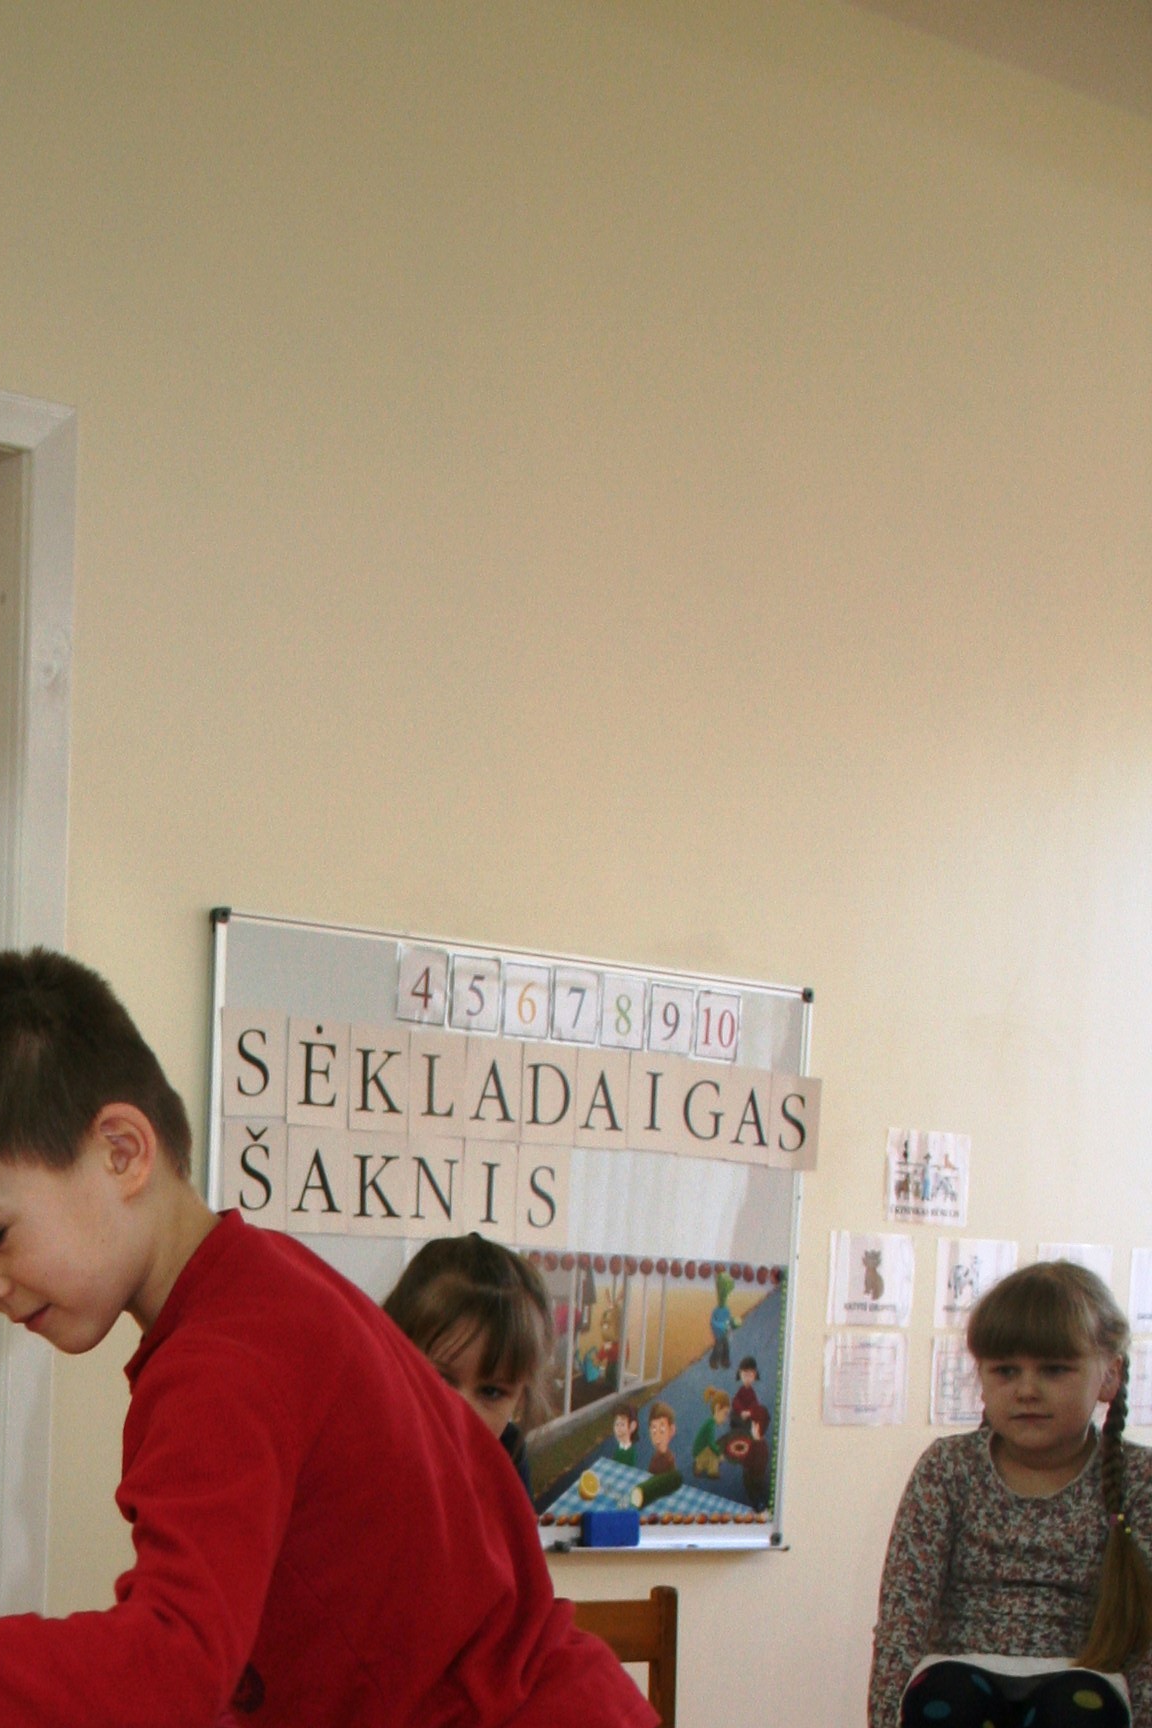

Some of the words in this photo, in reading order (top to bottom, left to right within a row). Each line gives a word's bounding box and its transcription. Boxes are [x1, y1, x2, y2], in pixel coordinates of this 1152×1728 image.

[410, 966, 433, 1010] 4
[466, 974, 486, 1017] 5
[516, 981, 538, 1025] 6
[568, 986, 588, 1030] 7
[614, 994, 632, 1037] 8
[661, 1001, 682, 1041] 9
[701, 1006, 736, 1048] 10
[236, 1025, 808, 1153] SĖKLADAIGAS
[238, 1126, 557, 1229] ŠAKNIS
